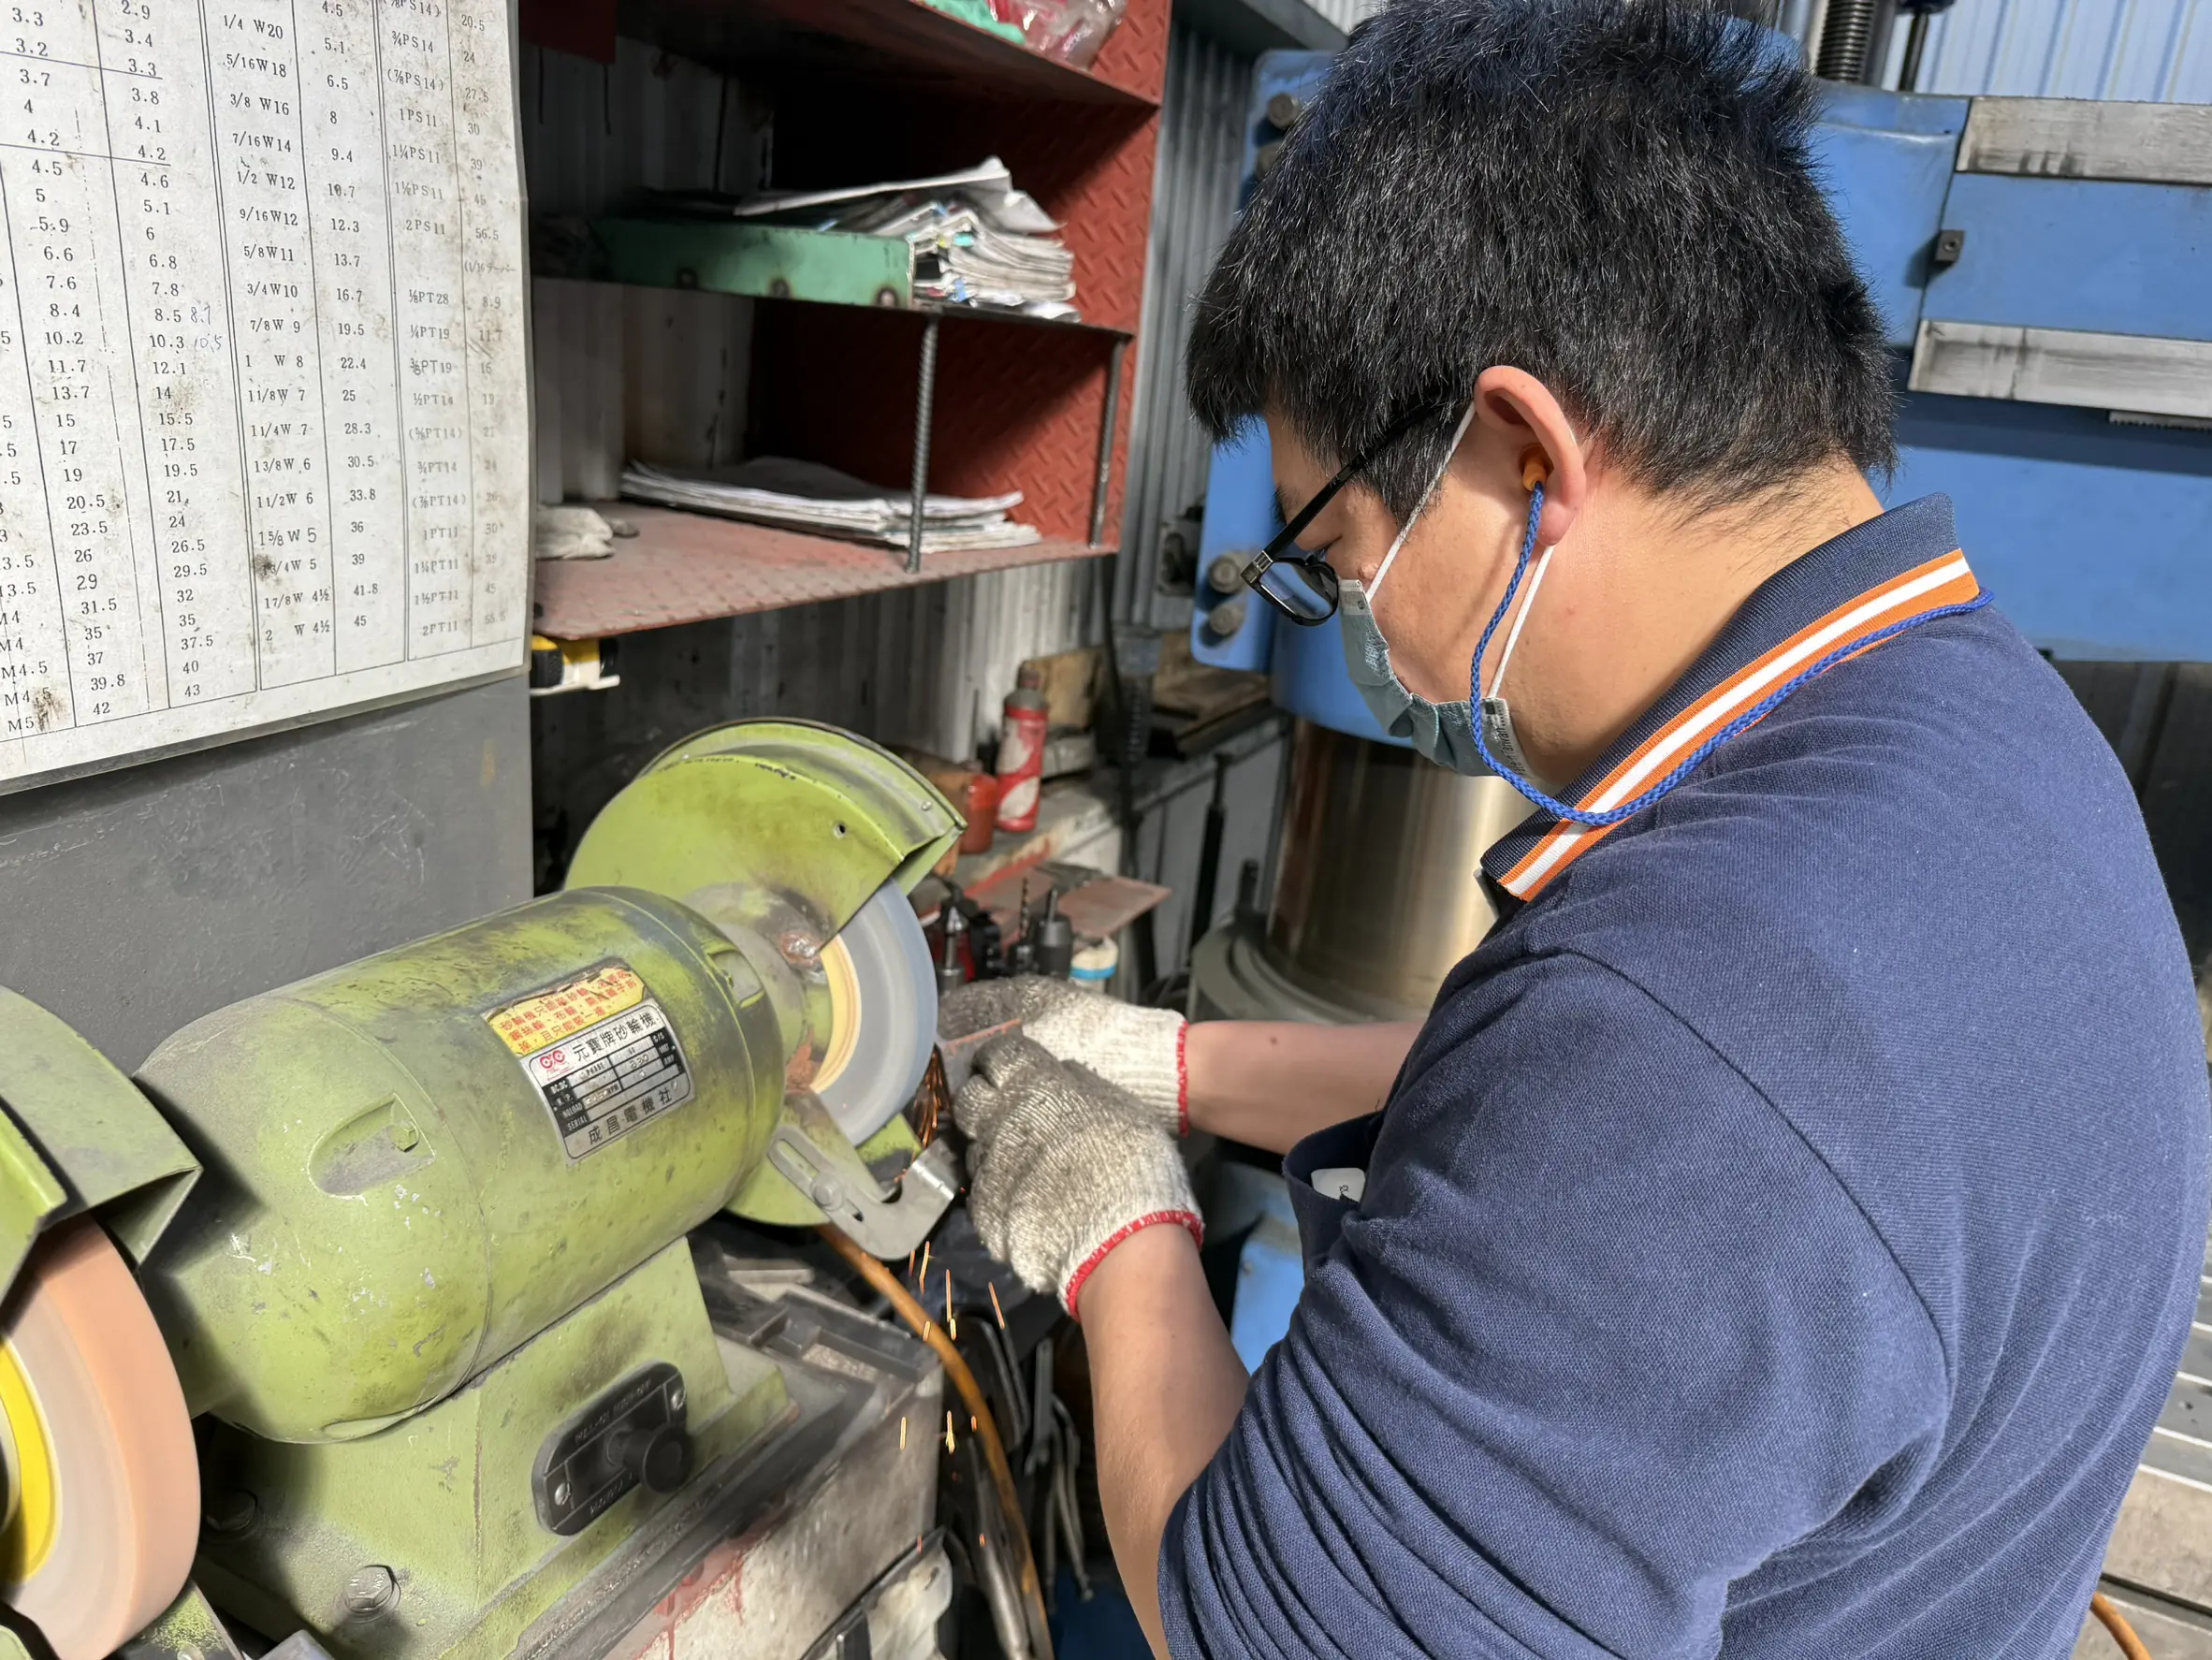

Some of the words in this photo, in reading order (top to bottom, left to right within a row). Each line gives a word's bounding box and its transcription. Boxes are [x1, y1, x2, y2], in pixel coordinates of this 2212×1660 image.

[122, 0, 151, 20] 2.9
[322, 1, 342, 17] 4.5
[12, 7, 43, 26] 3.3
[224, 14, 243, 30] 1/4
[461, 14, 485, 32] 20.5
[124, 29, 153, 48] 3.4
[325, 37, 345, 54] 5.1
[16, 38, 48, 56] 3.2
[463, 51, 475, 64] 24
[128, 58, 156, 77] 3.3
[20, 69, 51, 86] 3.7
[327, 74, 348, 91] 6.5
[132, 88, 159, 105] 3.8
[230, 92, 251, 108] 3/8
[465, 87, 489, 103] 27.5
[23, 99, 34, 113] 4
[329, 110, 338, 124] 8
[135, 116, 161, 133] 4.1
[468, 123, 480, 136] 30
[27, 129, 60, 146] 4.2
[138, 144, 166, 160] 4.2
[331, 148, 353, 162] 9.4
[32, 160, 63, 175] 4.5
[471, 158, 483, 170] 39
[140, 172, 168, 188] 4.6
[238, 169, 257, 184] 1/2
[36, 189, 46, 202] 5
[327, 183, 355, 198] 10.7
[144, 199, 170, 215] 5.1
[474, 194, 487, 206] 45
[39, 217, 69, 232] 5.9
[331, 218, 359, 233] 12.3
[146, 227, 155, 240] 6
[475, 227, 499, 241] 56.5
[44, 247, 73, 261] 6.6
[334, 253, 360, 268] 13.7
[149, 254, 177, 269] 6.8
[47, 276, 77, 290] 7.6
[153, 282, 180, 297] 7.8
[337, 288, 362, 302] 16.7
[50, 303, 80, 317] 8.4
[483, 297, 502, 309] 8.9
[154, 308, 182, 323] 8.5
[338, 323, 365, 336] 19.5
[479, 329, 502, 342] 11.7
[46, 332, 84, 345] 10.2
[149, 334, 184, 348] 10.3
[49, 360, 86, 373] 11.7
[153, 361, 186, 375] 12.1
[341, 357, 367, 370] 22.4
[52, 386, 90, 400] 13.7
[155, 386, 171, 400] 14
[342, 389, 357, 401] 25
[56, 415, 76, 428] 15
[159, 413, 193, 426] 15.5
[344, 423, 371, 435] 28.3
[61, 442, 77, 455] 17
[161, 438, 196, 452] 17.5
[347, 456, 374, 468] 30.5
[64, 469, 82, 482] 19
[164, 463, 198, 477] 19.5
[66, 495, 105, 509] 20.5
[167, 490, 182, 504] 21
[349, 488, 376, 502] 33.8
[71, 521, 108, 536] 23.5
[168, 516, 186, 529] 24
[351, 521, 364, 533] 36
[171, 539, 205, 553] 26.5
[75, 549, 93, 562] 26
[352, 553, 365, 565] 39
[173, 563, 208, 578] 29.5
[77, 575, 98, 590] 29
[354, 583, 378, 596] 41.8
[177, 590, 194, 603] 32
[80, 598, 117, 615] 31.5
[179, 614, 196, 627] 35
[354, 615, 367, 627] 45
[84, 626, 103, 641] 35
[181, 634, 213, 650] 37.5
[87, 652, 104, 665] 37
[1, 661, 48, 679] M4.5
[182, 661, 199, 674] 40
[91, 674, 125, 691] 39.8
[184, 684, 200, 697] 43
[93, 702, 110, 715] 42
[8, 716, 35, 732] M5
[573, 1012, 656, 1062] 元寶牌砂輪機
[568, 1115, 587, 1130] SERIAL
[589, 1087, 672, 1145] 成昌電機社
